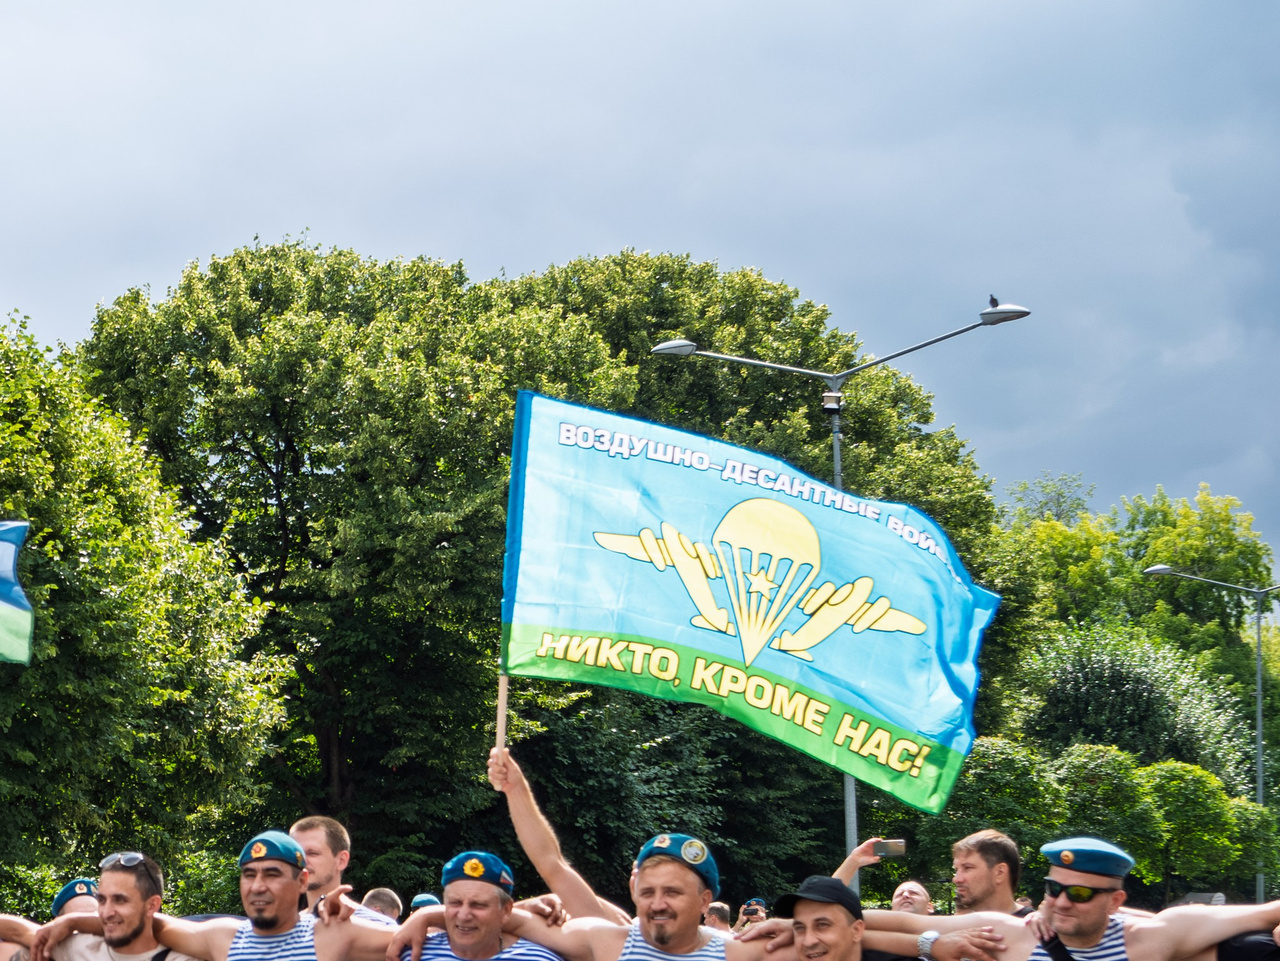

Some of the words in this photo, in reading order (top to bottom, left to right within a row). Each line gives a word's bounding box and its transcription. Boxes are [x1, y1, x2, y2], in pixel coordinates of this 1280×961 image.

[558, 422, 881, 521] ВОЗДУШНО-ДЕСАНТНЫЕ
[535, 632, 681, 687] НИКТО,
[691, 658, 830, 737] КРОМЕ
[833, 714, 931, 778] НАС!
